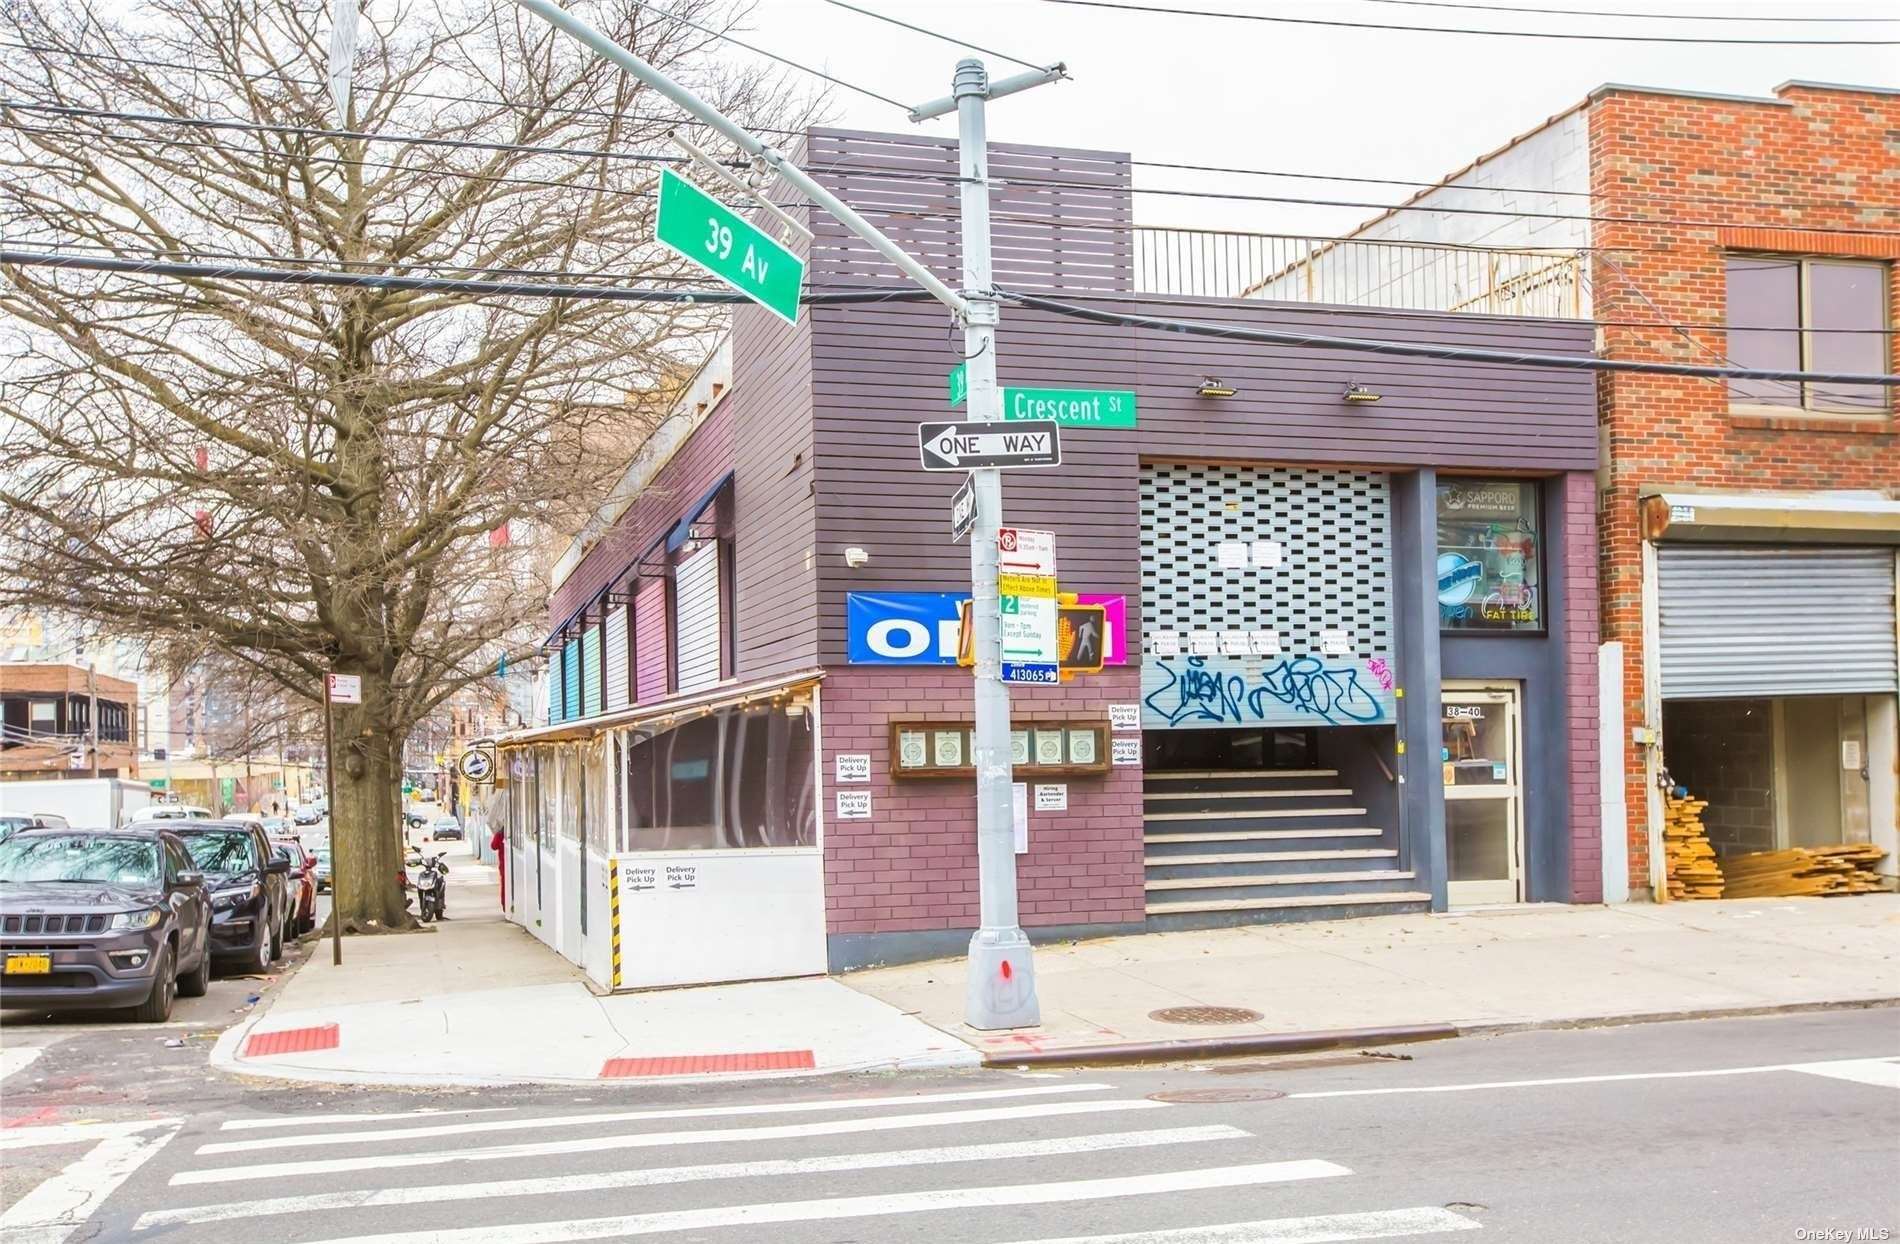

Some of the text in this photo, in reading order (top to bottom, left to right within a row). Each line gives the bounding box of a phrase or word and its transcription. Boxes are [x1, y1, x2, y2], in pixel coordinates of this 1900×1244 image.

[705, 217, 768, 285] 39 Av
[1014, 393, 1122, 421] Crescent St
[939, 434, 1045, 455] ONE WAY
[1467, 491, 1516, 504] SAPPORO
[1005, 595, 1015, 612] 2
[1487, 610, 1506, 620] FAT
[1010, 668, 1044, 681] 413065
[1112, 706, 1137, 714] Delivery
[1447, 707, 1480, 717] 38-40
[1112, 741, 1137, 749] Delivery
[857, 765, 867, 773] Up
[840, 793, 868, 801] Delivery
[858, 801, 867, 809] Up
[625, 868, 656, 876] Delivery
[666, 866, 696, 874] Delivery
[644, 876, 655, 884] Up
[684, 873, 695, 882] Up
